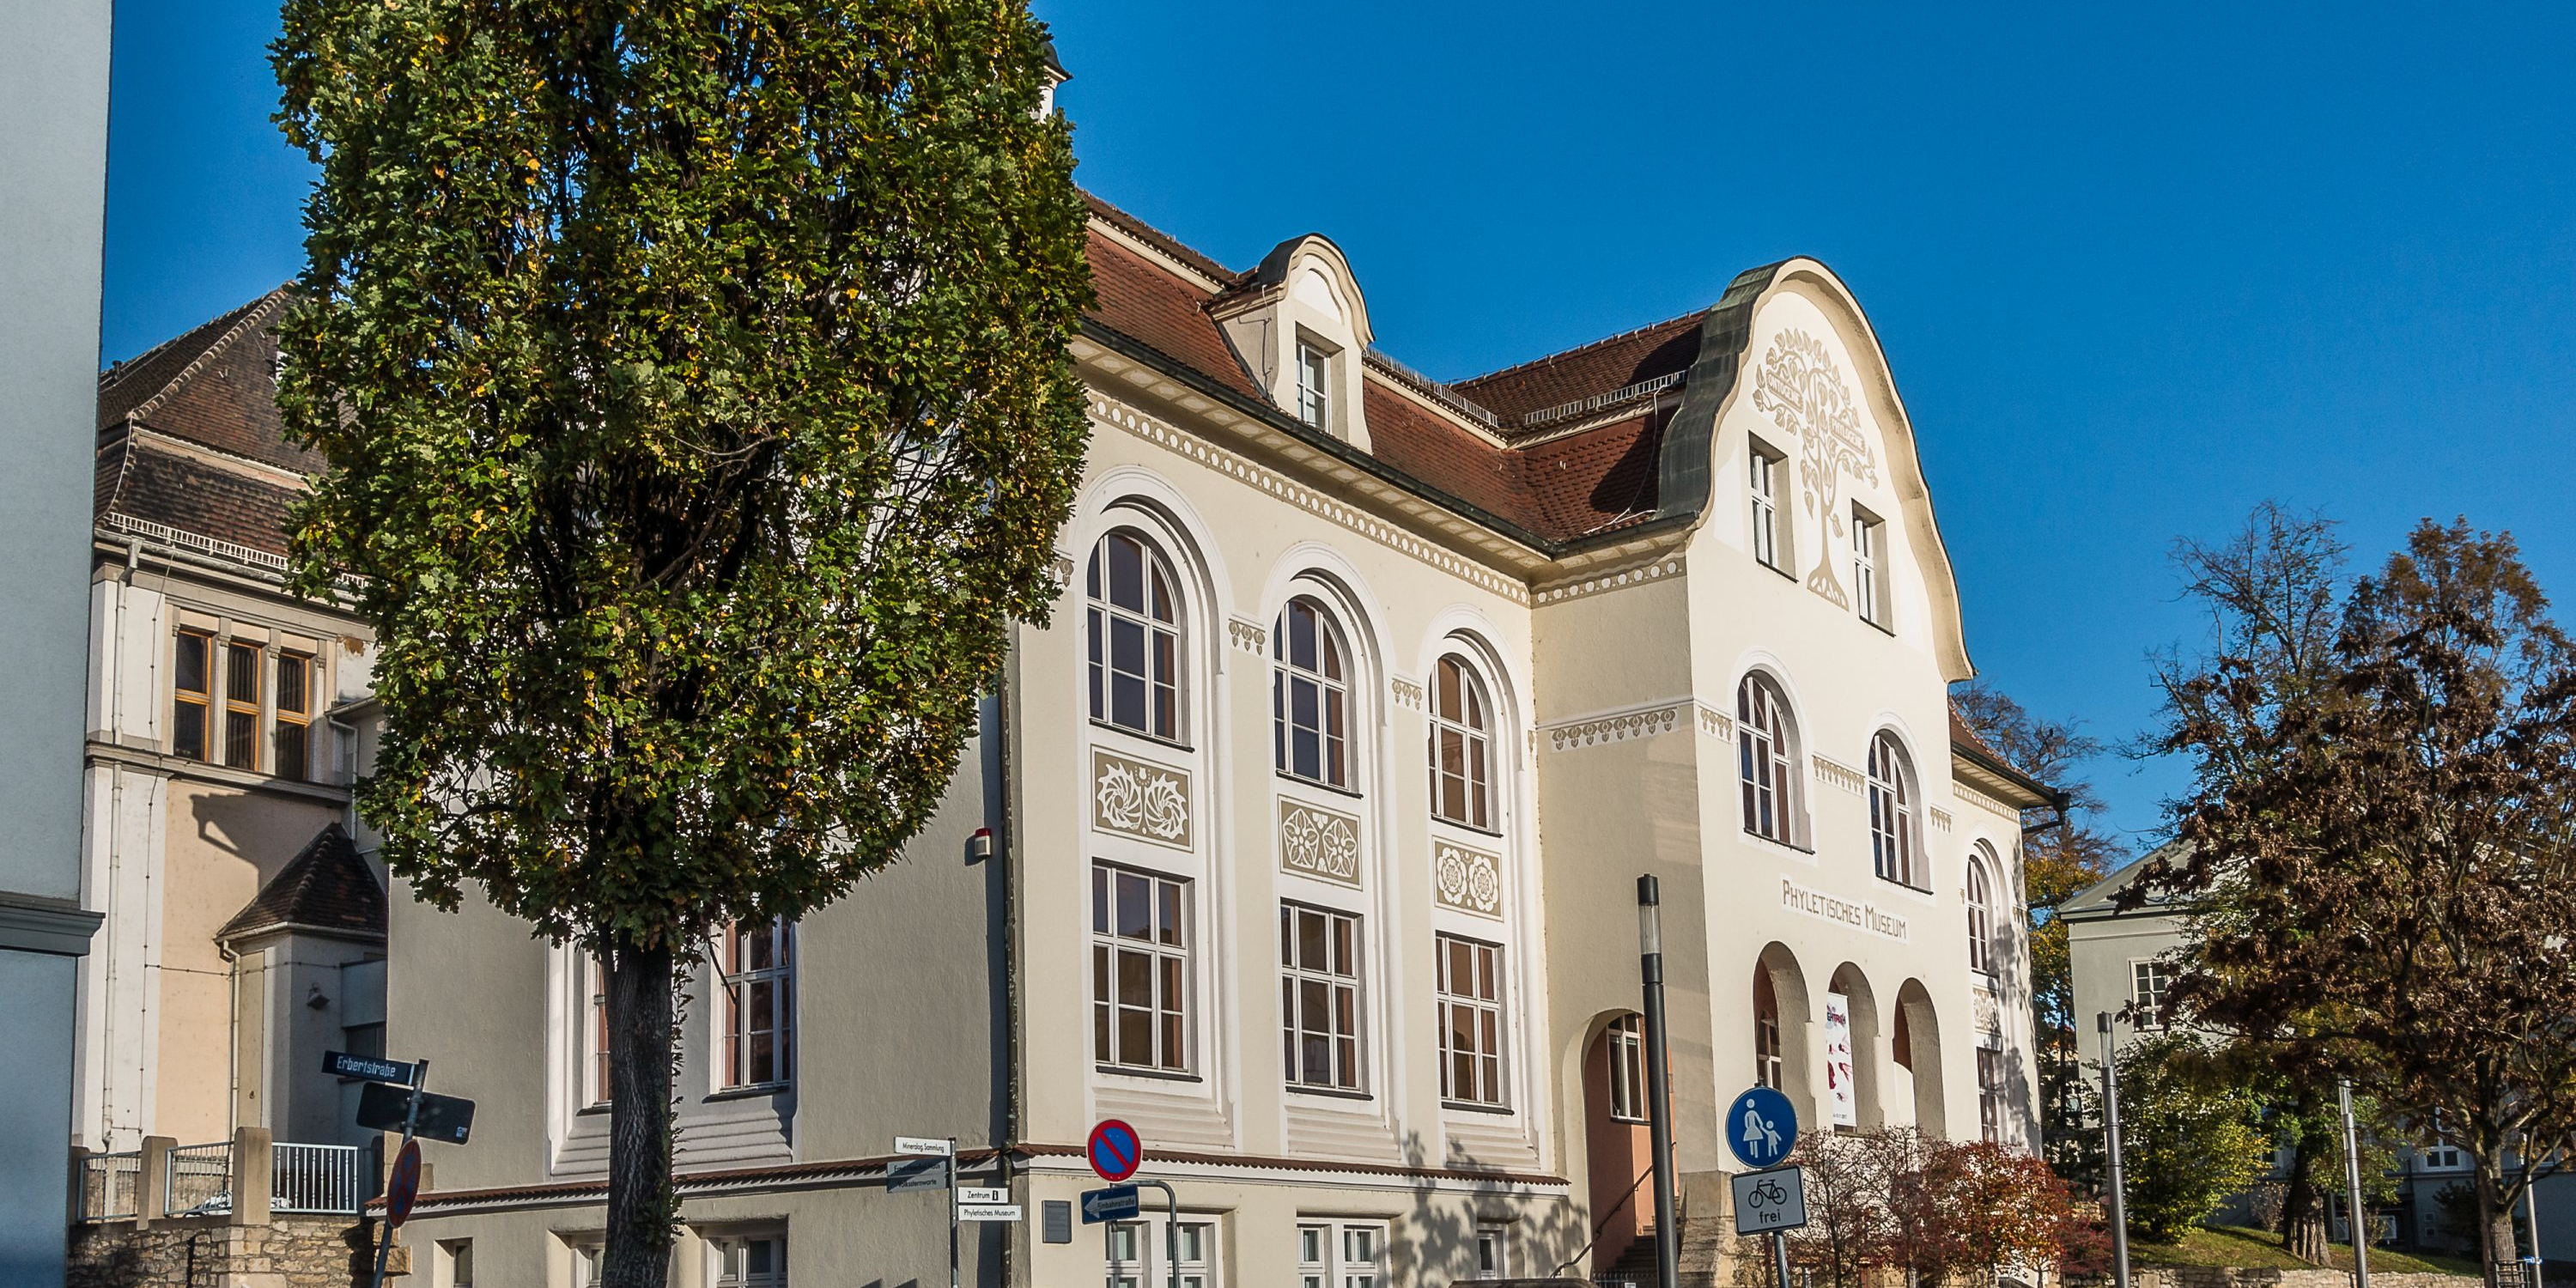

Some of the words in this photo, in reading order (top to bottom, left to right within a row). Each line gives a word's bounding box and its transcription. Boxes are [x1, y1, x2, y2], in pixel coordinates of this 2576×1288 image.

[337, 1055, 396, 1077] Erbertstraße
[924, 1143, 945, 1153] Sammlung
[963, 1209, 993, 1218] Phyletisches
[1759, 1209, 1781, 1224] frei
